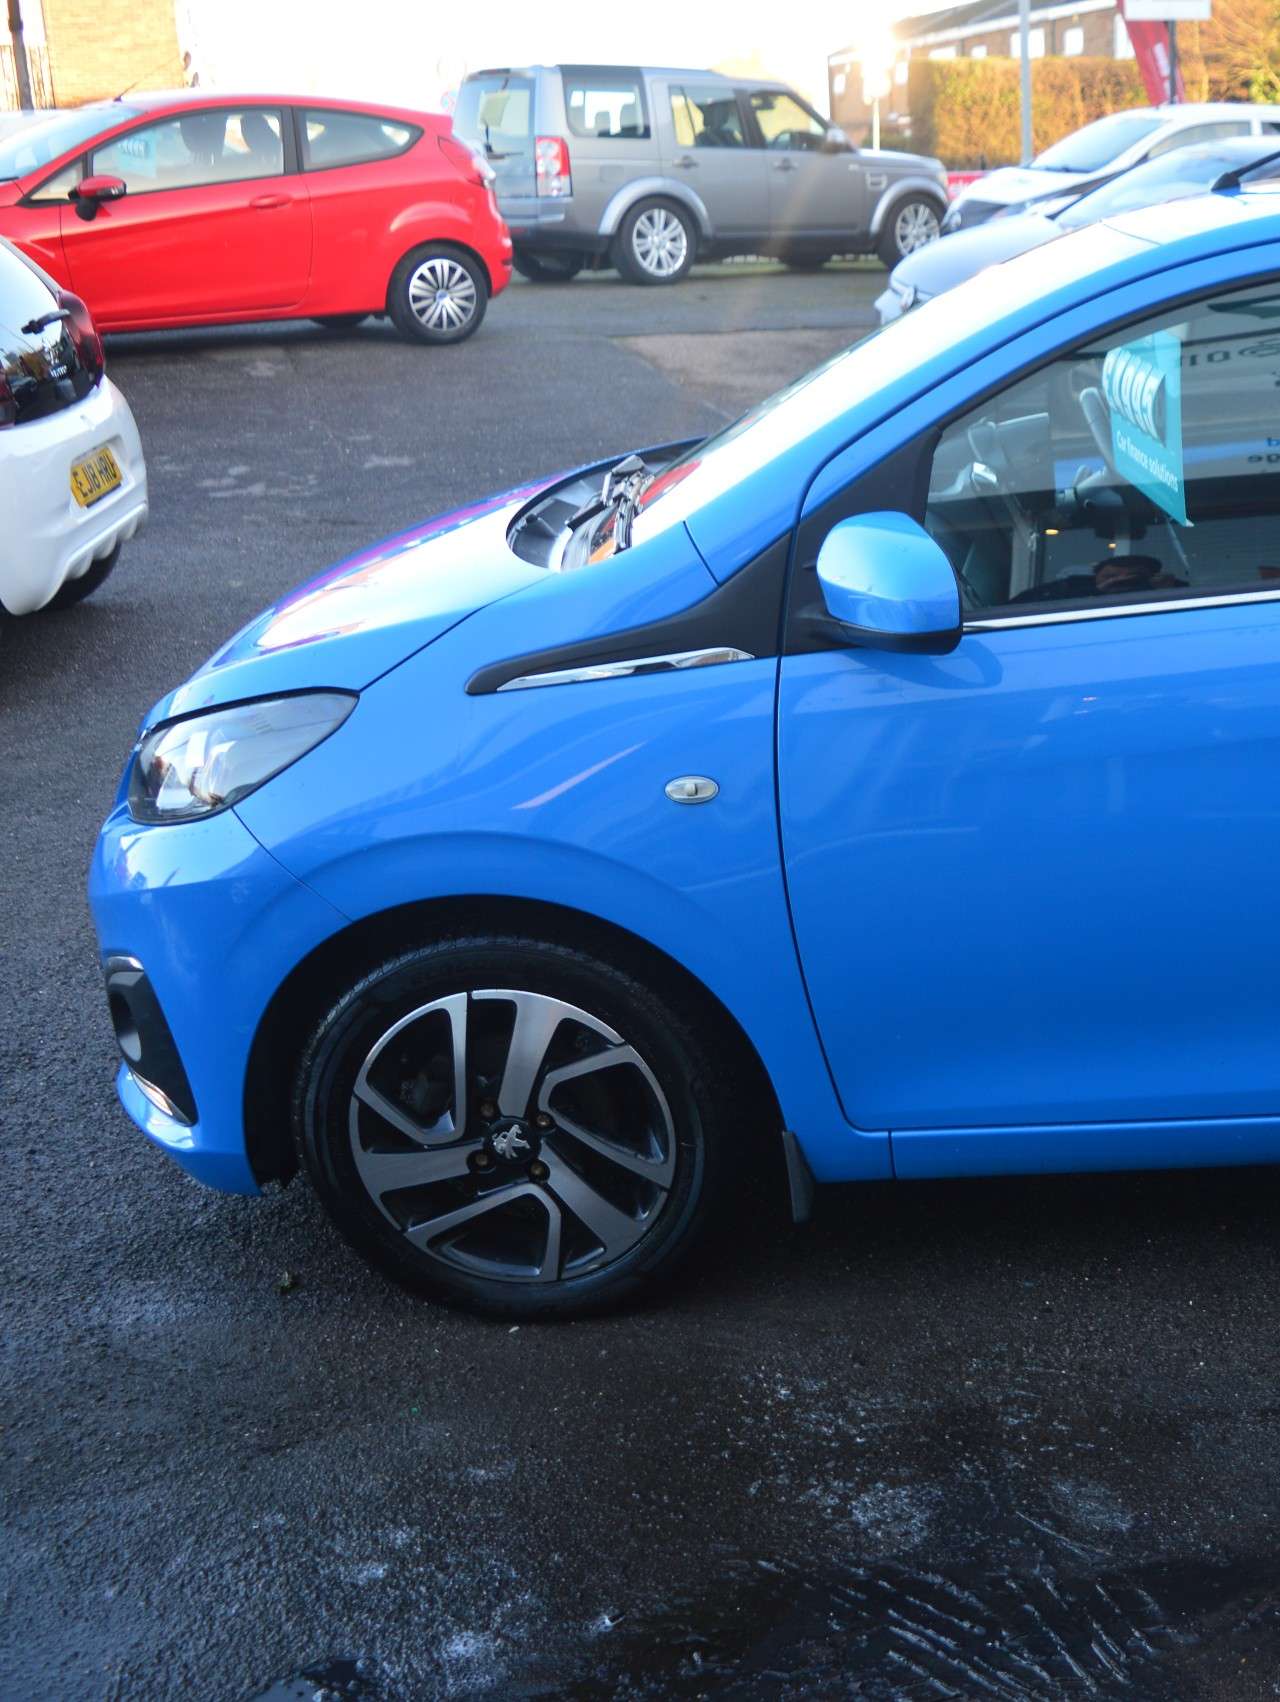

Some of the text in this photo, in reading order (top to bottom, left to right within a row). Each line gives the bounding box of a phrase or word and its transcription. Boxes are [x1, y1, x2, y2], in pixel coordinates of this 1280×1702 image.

[1116, 429, 1179, 493] Car finance solutions
